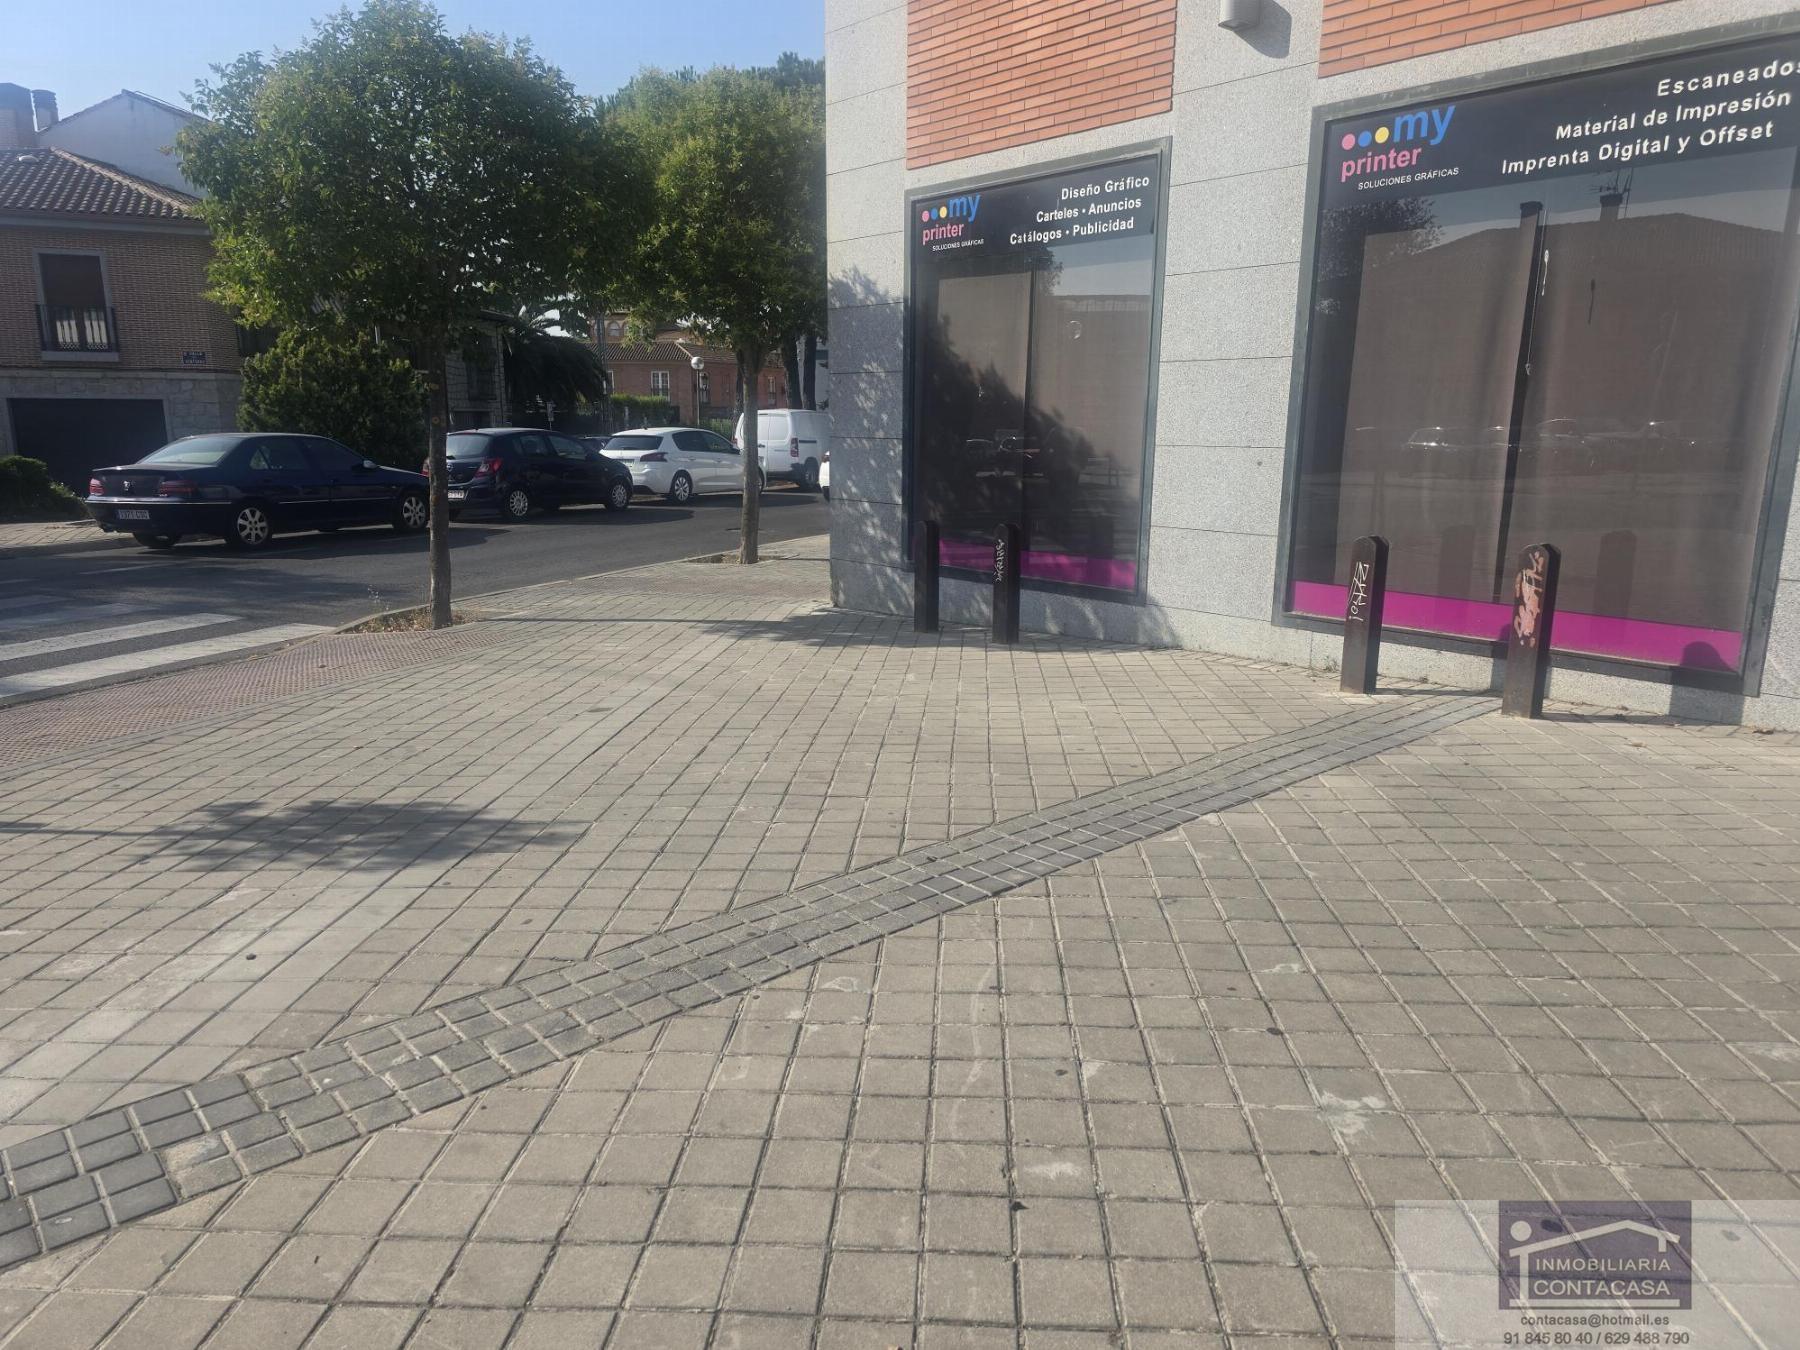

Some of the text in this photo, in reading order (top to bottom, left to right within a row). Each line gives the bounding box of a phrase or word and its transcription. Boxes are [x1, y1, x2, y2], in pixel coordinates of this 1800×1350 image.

[1393, 105, 1456, 145] my
[1556, 89, 1792, 140] Material de Impresión
[1502, 121, 1774, 175] Imprenta Digital y Offset
[1341, 148, 1422, 183] printer
[1358, 167, 1459, 190] SOLUCIONES GRÁFICAS
[1061, 176, 1150, 200] Diseño Gráfico
[949, 193, 981, 222] my
[1036, 198, 1142, 223] Carteles Anuncios
[922, 223, 965, 246] printer
[1010, 217, 1134, 244] Catálogos Publicidad
